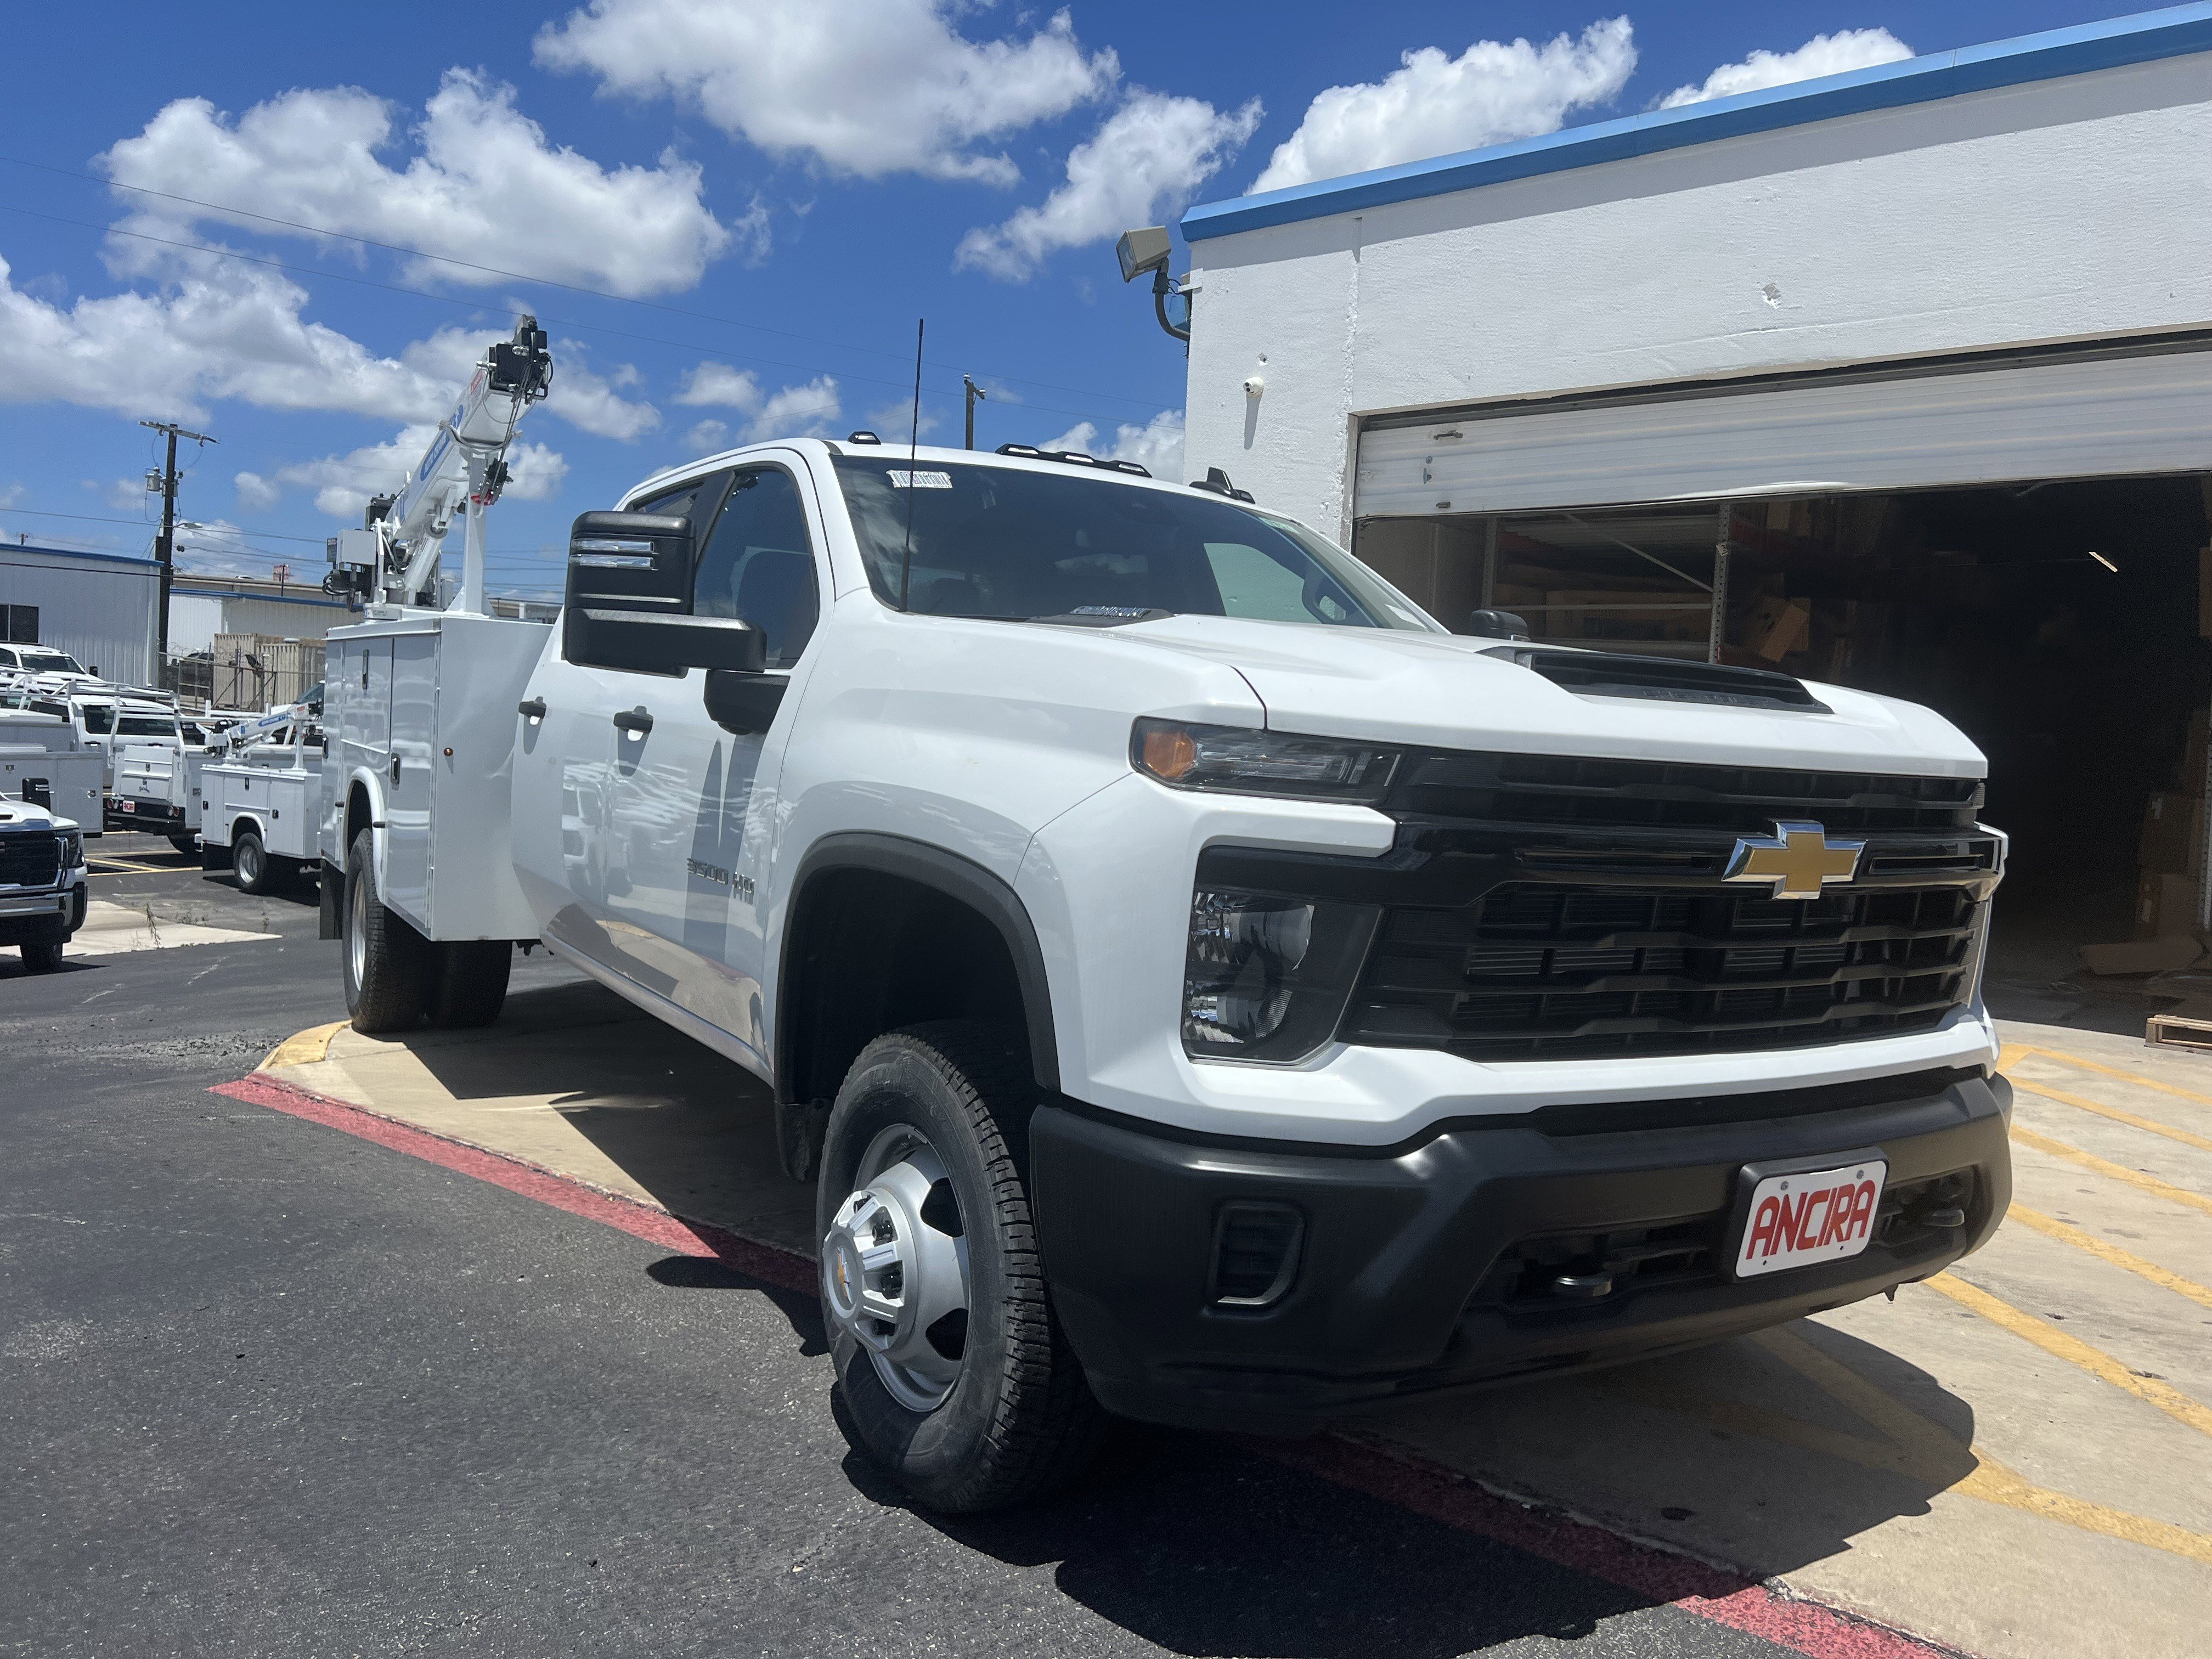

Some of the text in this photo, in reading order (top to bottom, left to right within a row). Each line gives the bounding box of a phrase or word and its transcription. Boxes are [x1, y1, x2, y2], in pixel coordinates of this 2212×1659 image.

[687, 857, 755, 895] 3500 HD
[1745, 1180, 1875, 1260] ANCIRA
